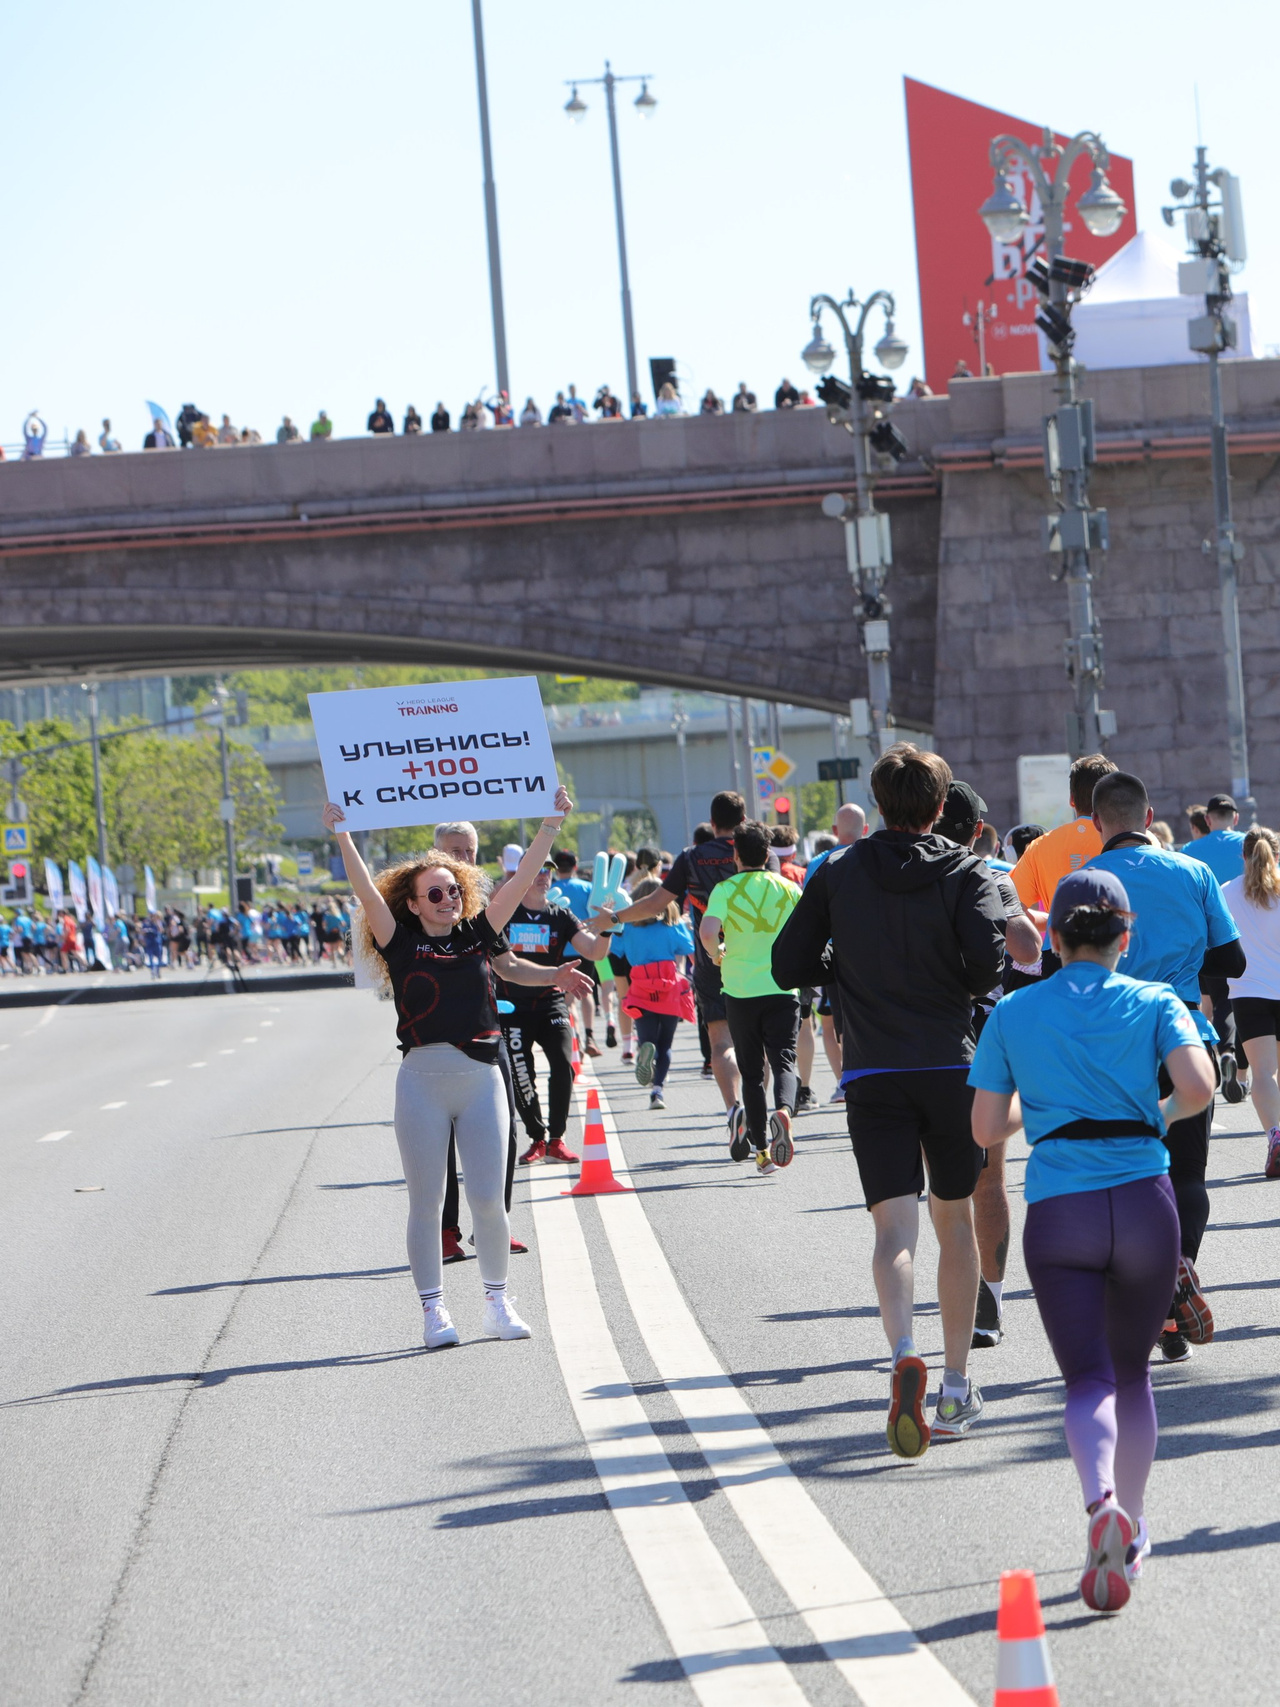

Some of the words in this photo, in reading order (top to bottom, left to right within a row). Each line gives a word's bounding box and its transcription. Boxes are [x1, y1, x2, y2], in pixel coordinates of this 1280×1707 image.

[397, 703, 459, 717] TRAINING
[339, 731, 531, 762] УЛЫБНИСЬ!
[402, 757, 479, 780] +100
[343, 789, 364, 807] К
[376, 776, 546, 804] СКОРОСТИ
[518, 932, 541, 943] 20011
[509, 1026, 523, 1051] NO
